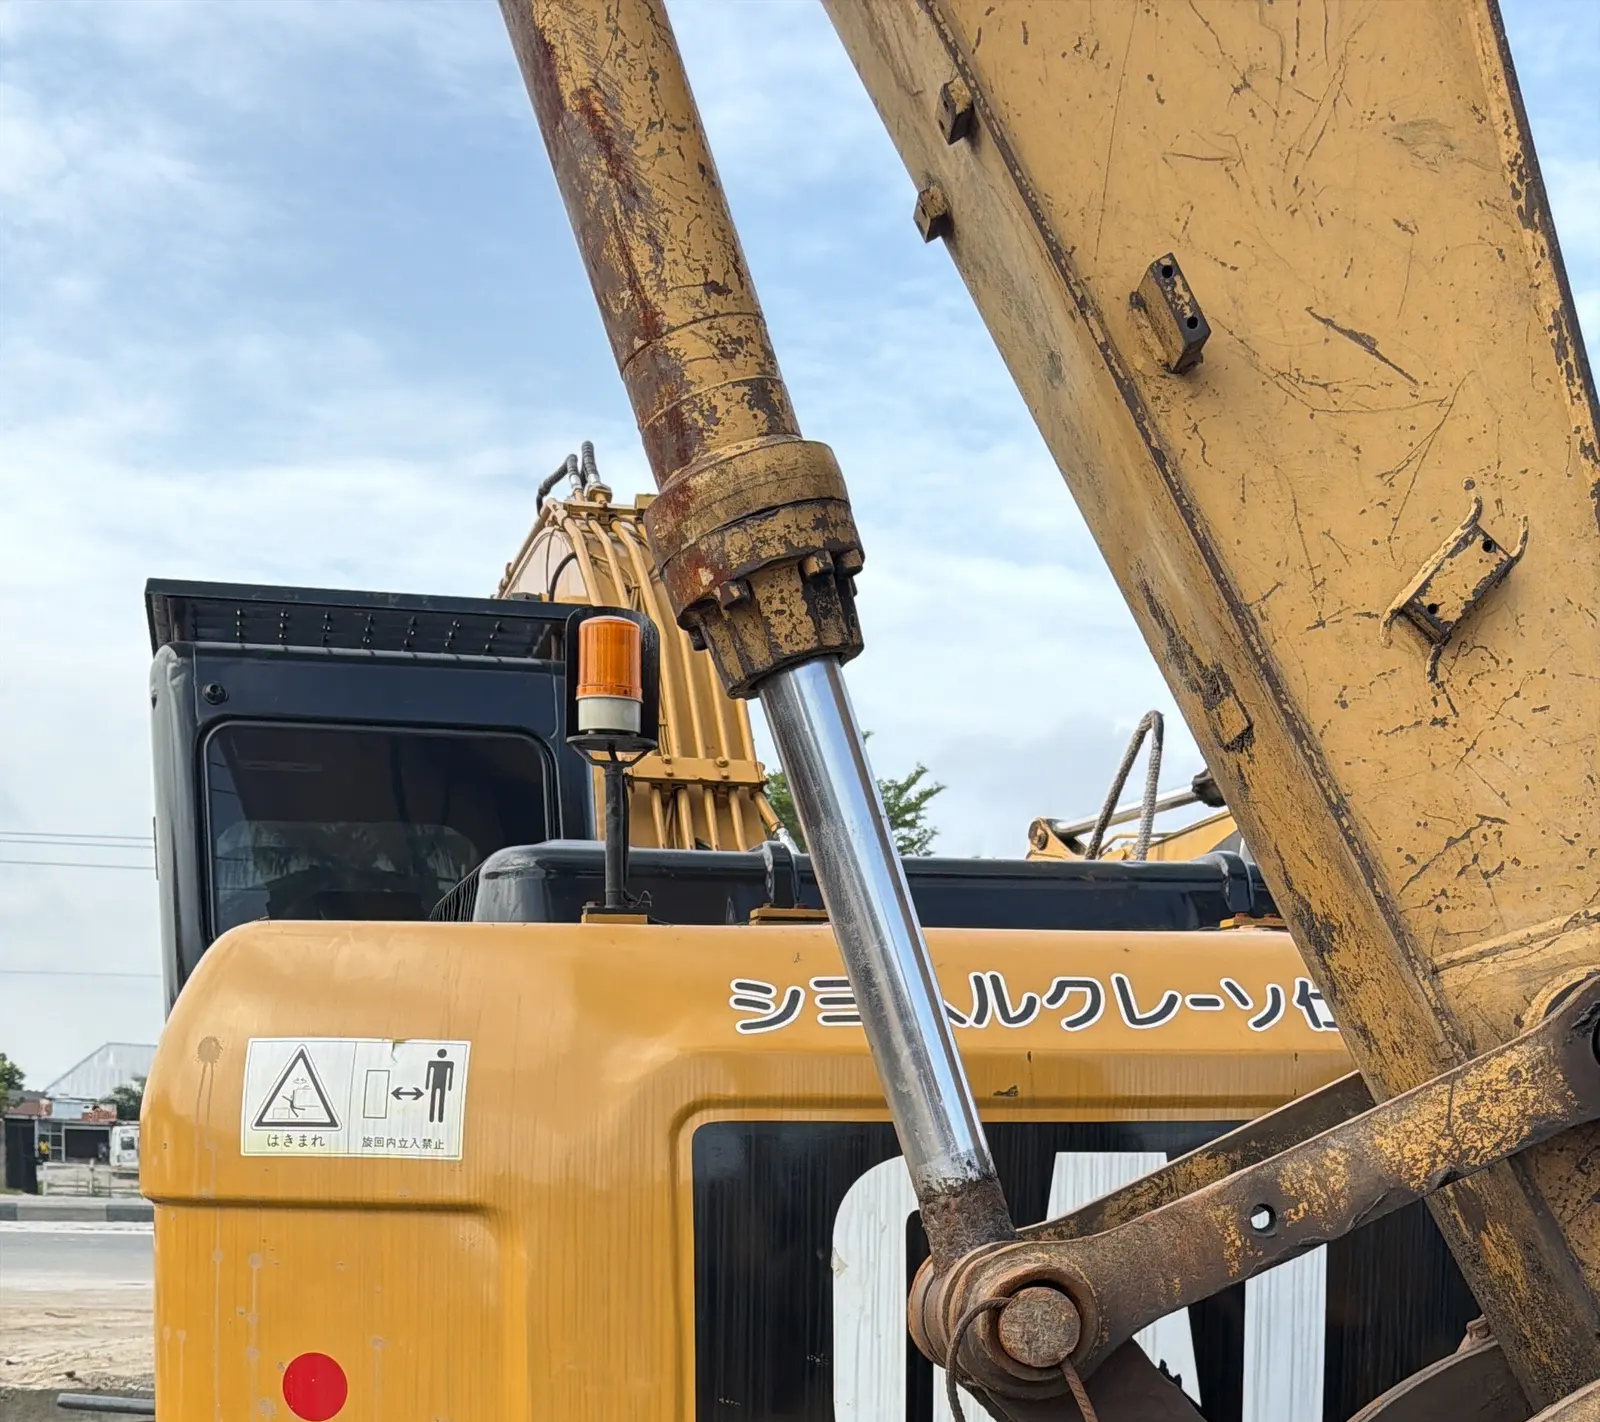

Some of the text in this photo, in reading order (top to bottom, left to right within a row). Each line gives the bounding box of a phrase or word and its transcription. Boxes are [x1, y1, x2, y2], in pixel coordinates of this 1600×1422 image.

[362, 1136, 446, 1150] 旋回内立入禁止
